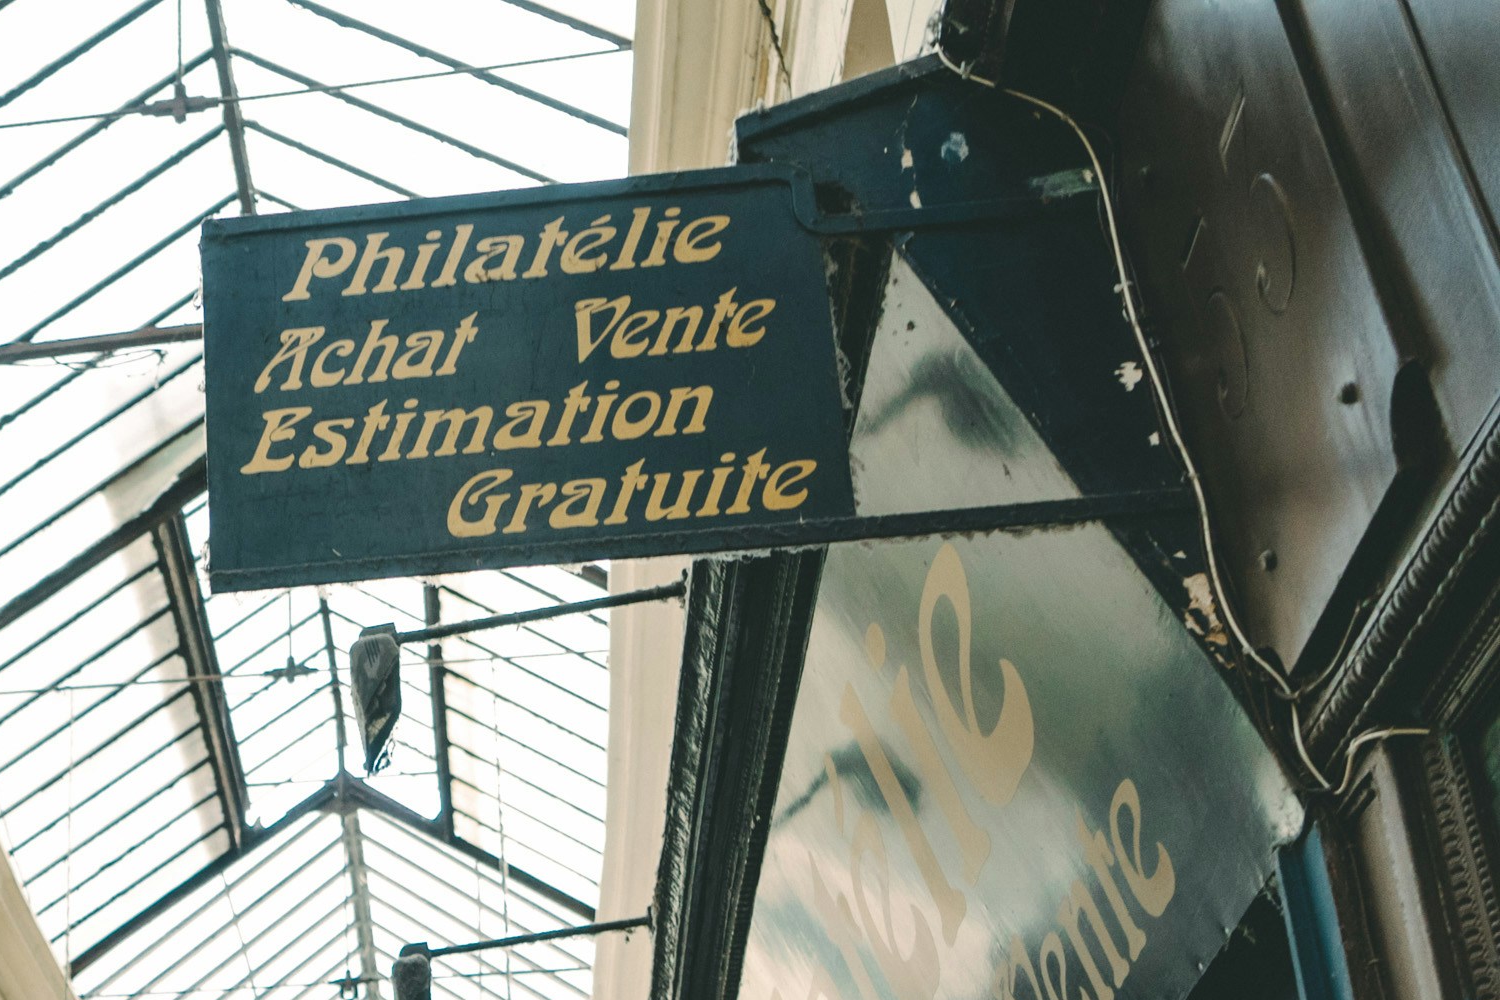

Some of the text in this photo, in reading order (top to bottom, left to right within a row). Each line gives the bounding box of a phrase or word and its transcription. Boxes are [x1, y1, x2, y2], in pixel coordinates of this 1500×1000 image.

[282, 206, 731, 302] Philatélie
[253, 286, 777, 394] Achat Vente
[240, 379, 715, 476] Estimation
[446, 446, 818, 539] Gratuite
